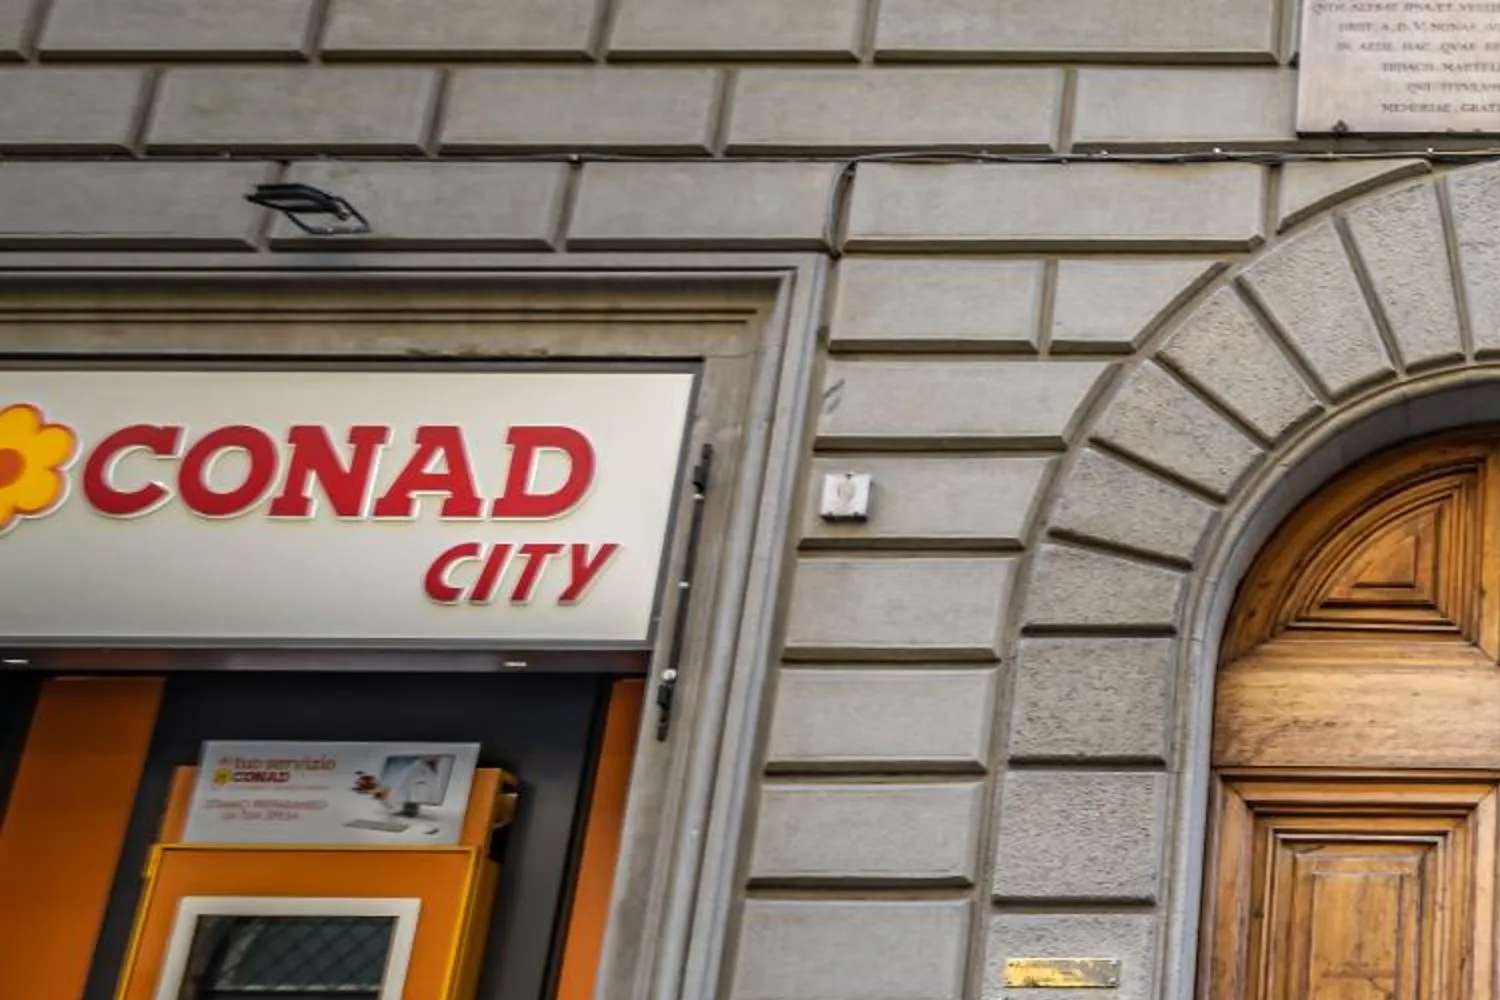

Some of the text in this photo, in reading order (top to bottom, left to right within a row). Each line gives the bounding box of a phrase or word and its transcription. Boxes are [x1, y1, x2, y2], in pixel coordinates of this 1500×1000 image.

[83, 424, 597, 519] CONAD
[422, 541, 621, 606] CITY
[233, 770, 291, 783] CONAD
